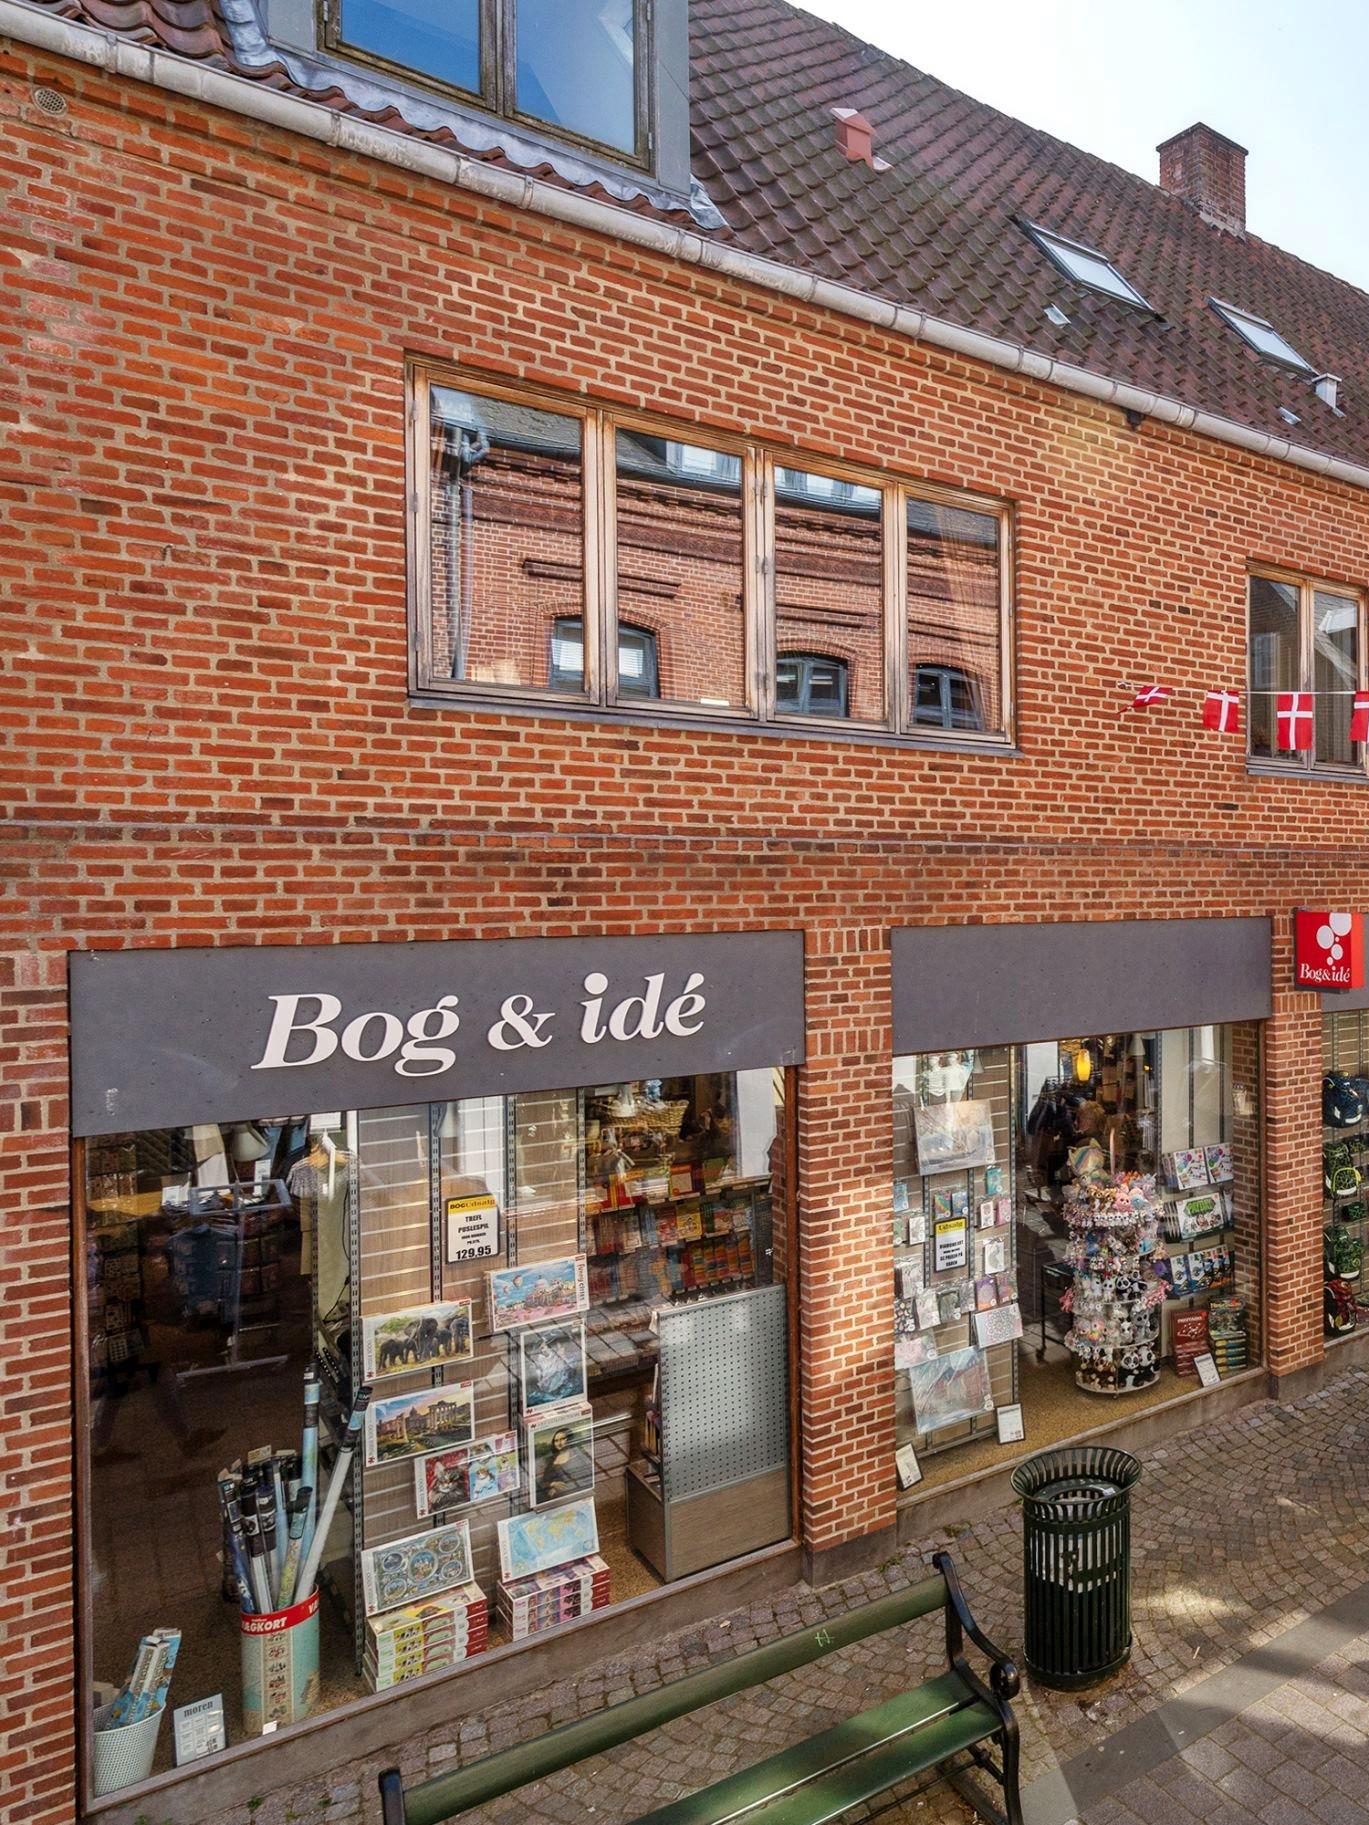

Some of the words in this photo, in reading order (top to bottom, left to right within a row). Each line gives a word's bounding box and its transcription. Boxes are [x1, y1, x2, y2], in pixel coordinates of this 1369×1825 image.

[250, 993, 460, 1077] Bog
[487, 994, 556, 1051] &
[580, 972, 706, 1044] idé
